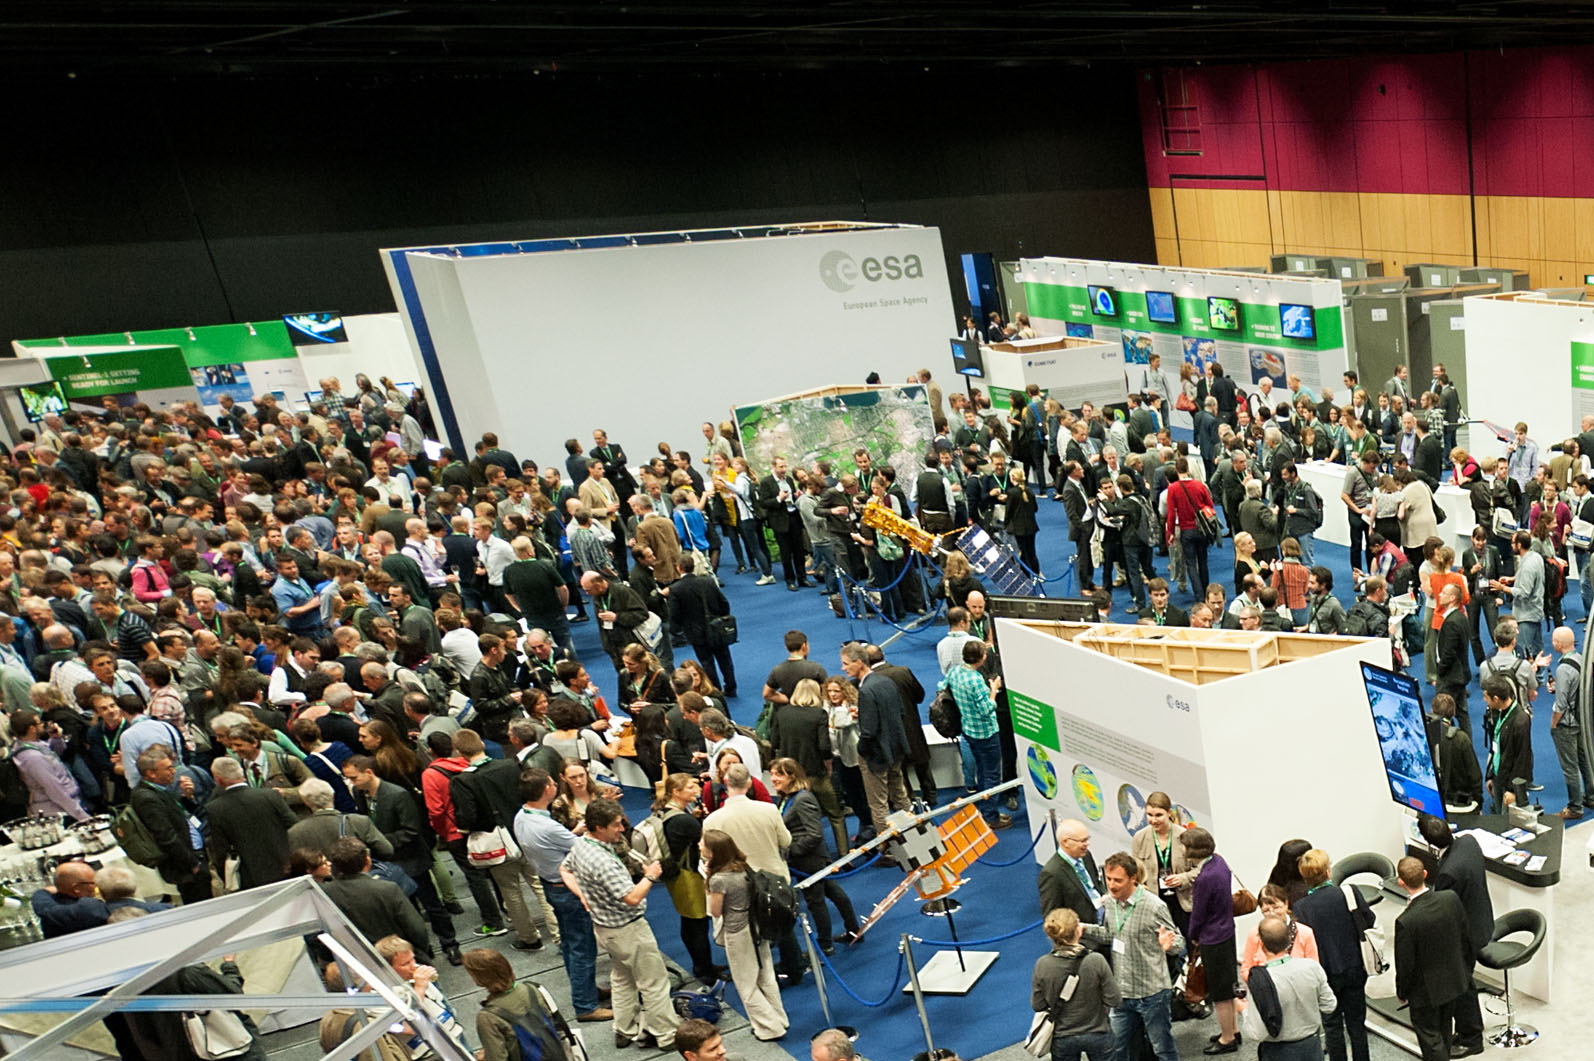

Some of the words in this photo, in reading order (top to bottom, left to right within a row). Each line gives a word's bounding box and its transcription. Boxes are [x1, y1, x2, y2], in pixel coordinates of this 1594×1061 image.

[862, 253, 924, 282] esa
[843, 301, 877, 310] European
[880, 298, 900, 307] Space
[903, 297, 928, 306] Agency
[1175, 699, 1190, 712] esa
